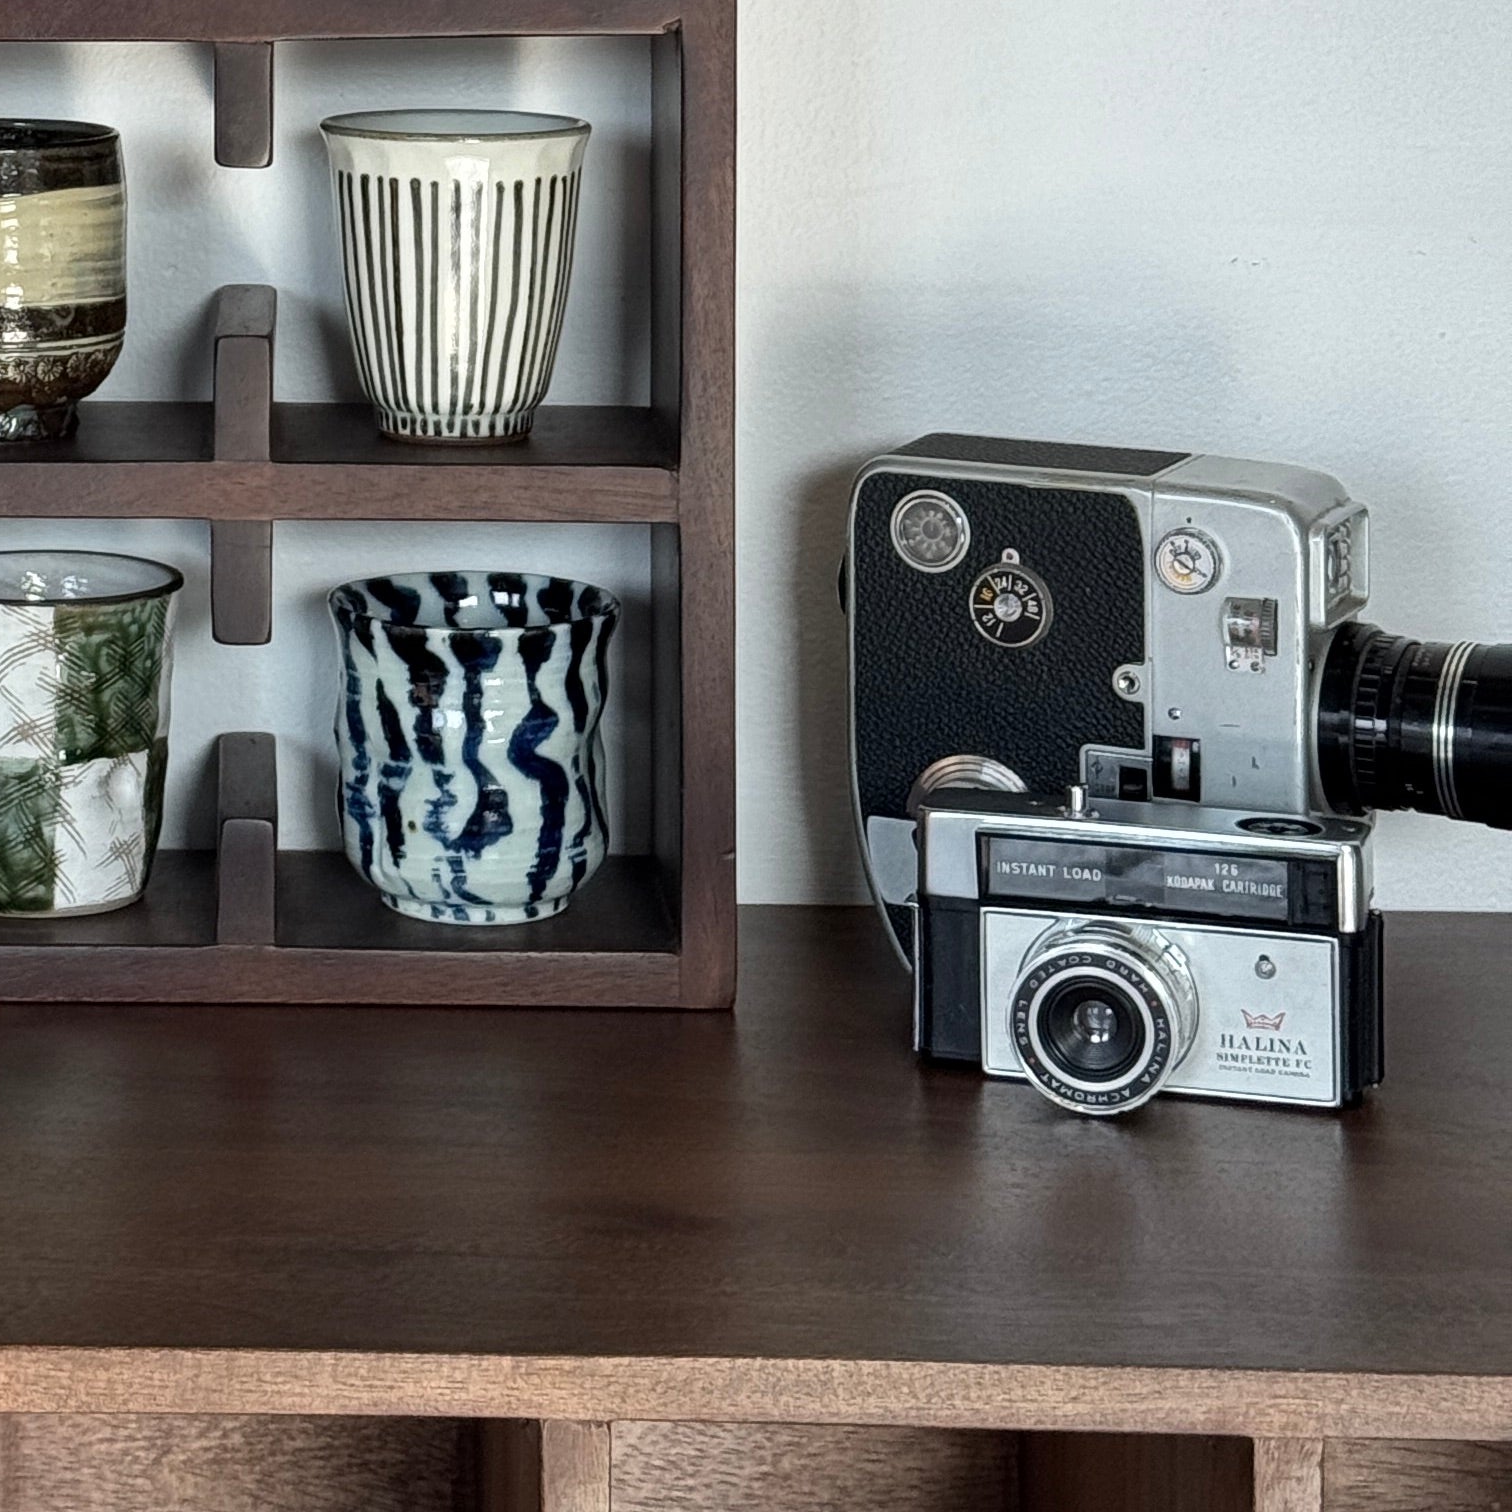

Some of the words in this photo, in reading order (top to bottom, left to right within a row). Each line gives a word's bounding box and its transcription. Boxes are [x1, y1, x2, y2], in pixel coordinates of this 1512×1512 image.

[994, 576, 1007, 589] 24
[1014, 580, 1028, 595] 32
[980, 587, 994, 601] 16
[1027, 599, 1039, 613] 48
[982, 612, 997, 627] 12
[996, 861, 1056, 878] INSTANT
[1063, 867, 1102, 882] LOAD
[1214, 863, 1238, 876] 126
[1167, 875, 1215, 891] KODAPAK
[1222, 879, 1283, 898] CARTRIDGE
[1029, 955, 1092, 988] COATED
[1106, 960, 1149, 993] HARD
[1016, 999, 1028, 1046] LENS
[1141, 1018, 1167, 1083] HALINA
[1220, 1033, 1308, 1056] HALINA
[1216, 1052, 1291, 1068] SIMPLETTE
[1295, 1059, 1313, 1070] FC
[1040, 1073, 1132, 1104] ACHROMAT
